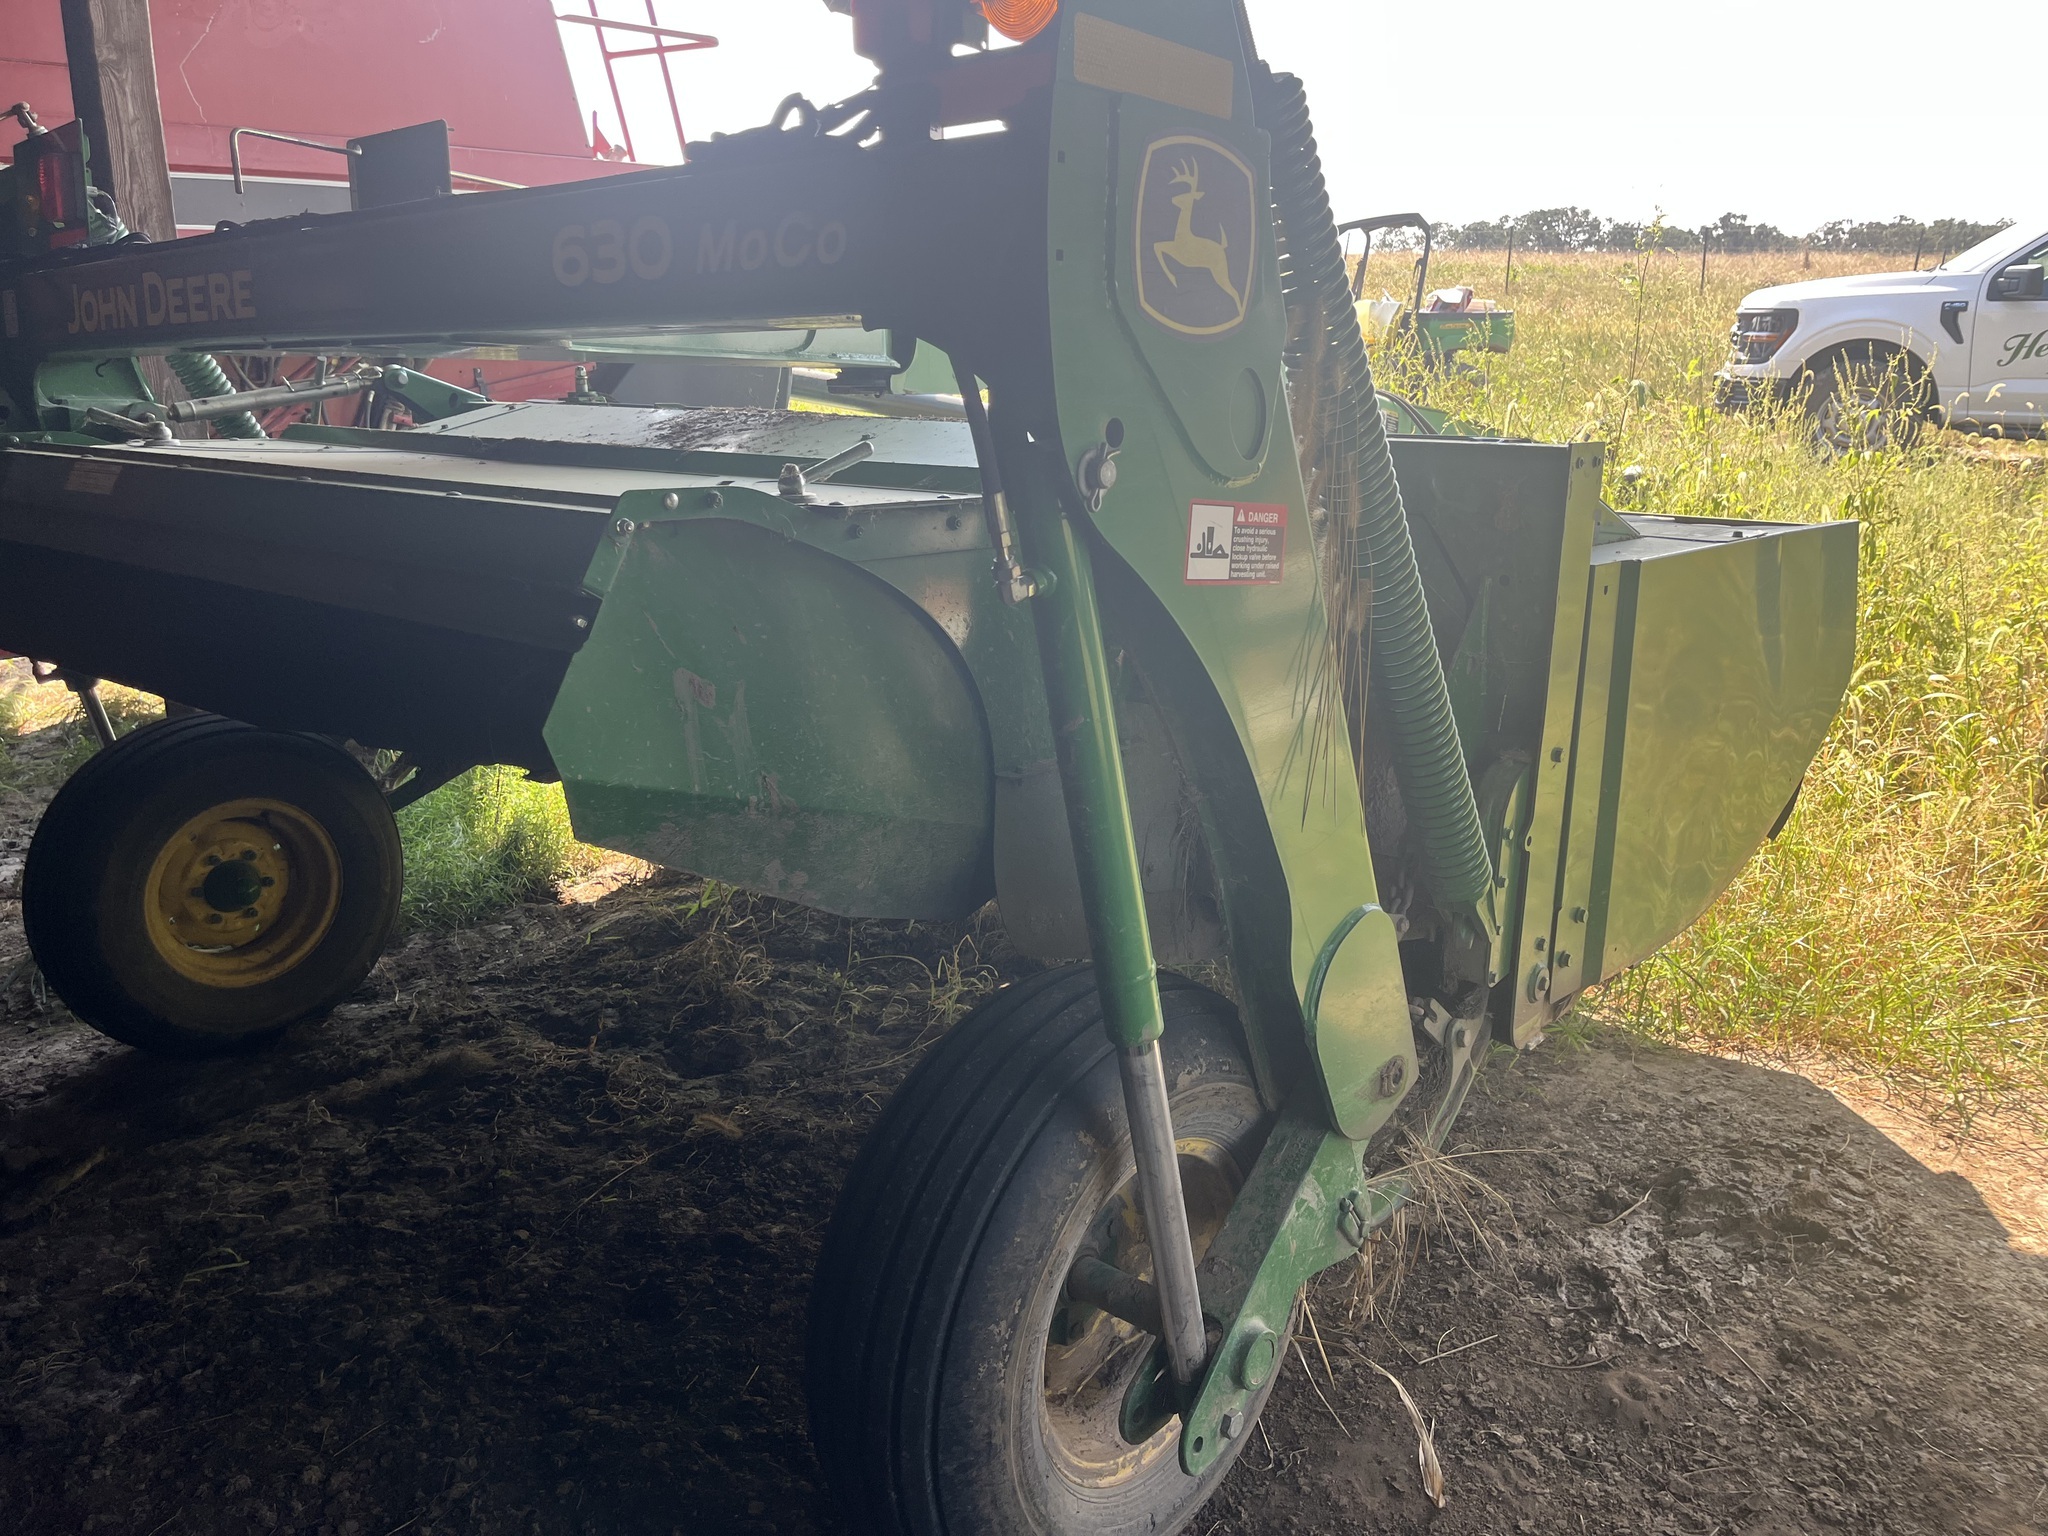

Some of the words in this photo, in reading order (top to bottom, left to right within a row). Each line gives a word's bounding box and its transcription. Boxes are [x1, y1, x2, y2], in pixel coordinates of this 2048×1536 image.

[552, 215, 674, 287] 630
[696, 210, 848, 275] MoCo
[68, 283, 139, 334] JOHN
[142, 270, 256, 326] DEERE
[1248, 511, 1279, 523] DANGER
[1234, 526, 1240, 534] To
[1241, 527, 1255, 535] avoid
[1232, 536, 1254, 545] crushing
[1246, 545, 1268, 554] hydraulic
[1231, 553, 1249, 563] lockup
[1231, 562, 1250, 571] working
[1250, 562, 1265, 570] under
[1265, 562, 1280, 570] raised
[1230, 570, 1255, 579] harvesting
